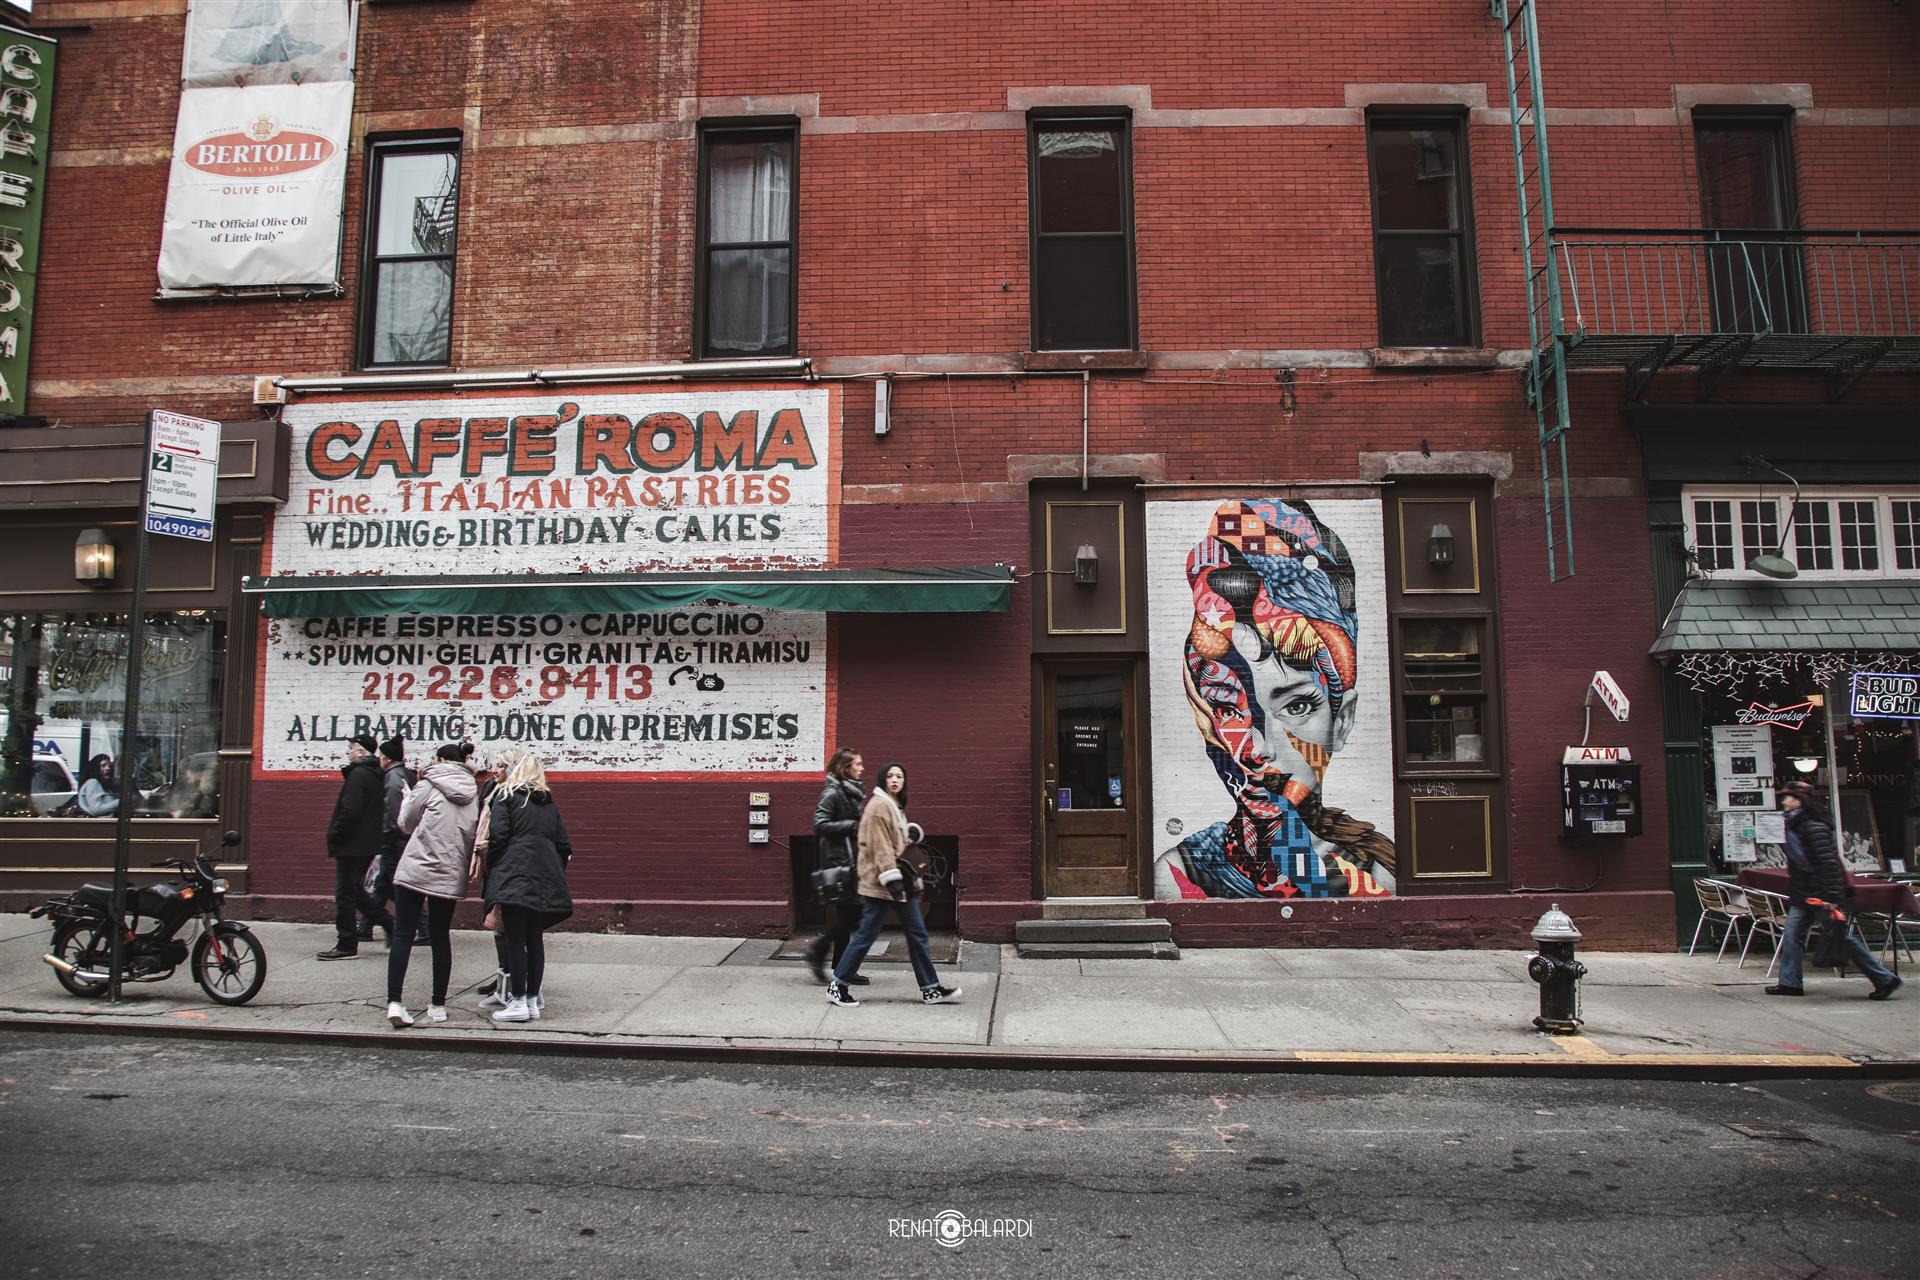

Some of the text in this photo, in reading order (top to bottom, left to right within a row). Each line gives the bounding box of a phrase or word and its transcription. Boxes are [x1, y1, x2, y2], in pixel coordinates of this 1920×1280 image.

[196, 142, 323, 166] BERTOLLI
[223, 185, 287, 195] OLIVE OIL
[220, 218, 259, 229] Official
[261, 217, 288, 227] Olive
[291, 216, 307, 226] Oil
[210, 233, 223, 243] of
[224, 232, 252, 243] Little
[158, 414, 205, 431] NO PARKING
[156, 432, 200, 447] Except Sunday
[575, 408, 818, 475] ROMA
[156, 454, 168, 470] 2
[152, 484, 197, 499] Except Sunday
[397, 476, 573, 513] ITALIAN
[584, 473, 791, 510] PASTRIES
[305, 519, 431, 550] WEDDING
[459, 512, 635, 548] BIRTHDAY
[655, 513, 782, 544] CAKES
[397, 613, 564, 638] ESPRESSO
[581, 612, 764, 637] CAPPUCCINO
[308, 643, 425, 667] SPUMONI
[436, 642, 532, 666] GELATI
[693, 641, 810, 663] TIRAMISU
[362, 672, 416, 701] 212
[1595, 677, 1618, 710] ATM
[1868, 677, 1917, 696] BUD
[86, 701, 126, 713] ITALIA
[1856, 694, 1920, 714] LIGHT
[1735, 708, 1811, 724] Budweiser
[287, 713, 799, 742] ALL BAKING DONE ON PREMISES
[1581, 747, 1620, 760] ATM
[1593, 779, 1616, 790] ATM
[1564, 766, 1573, 827] ATM
